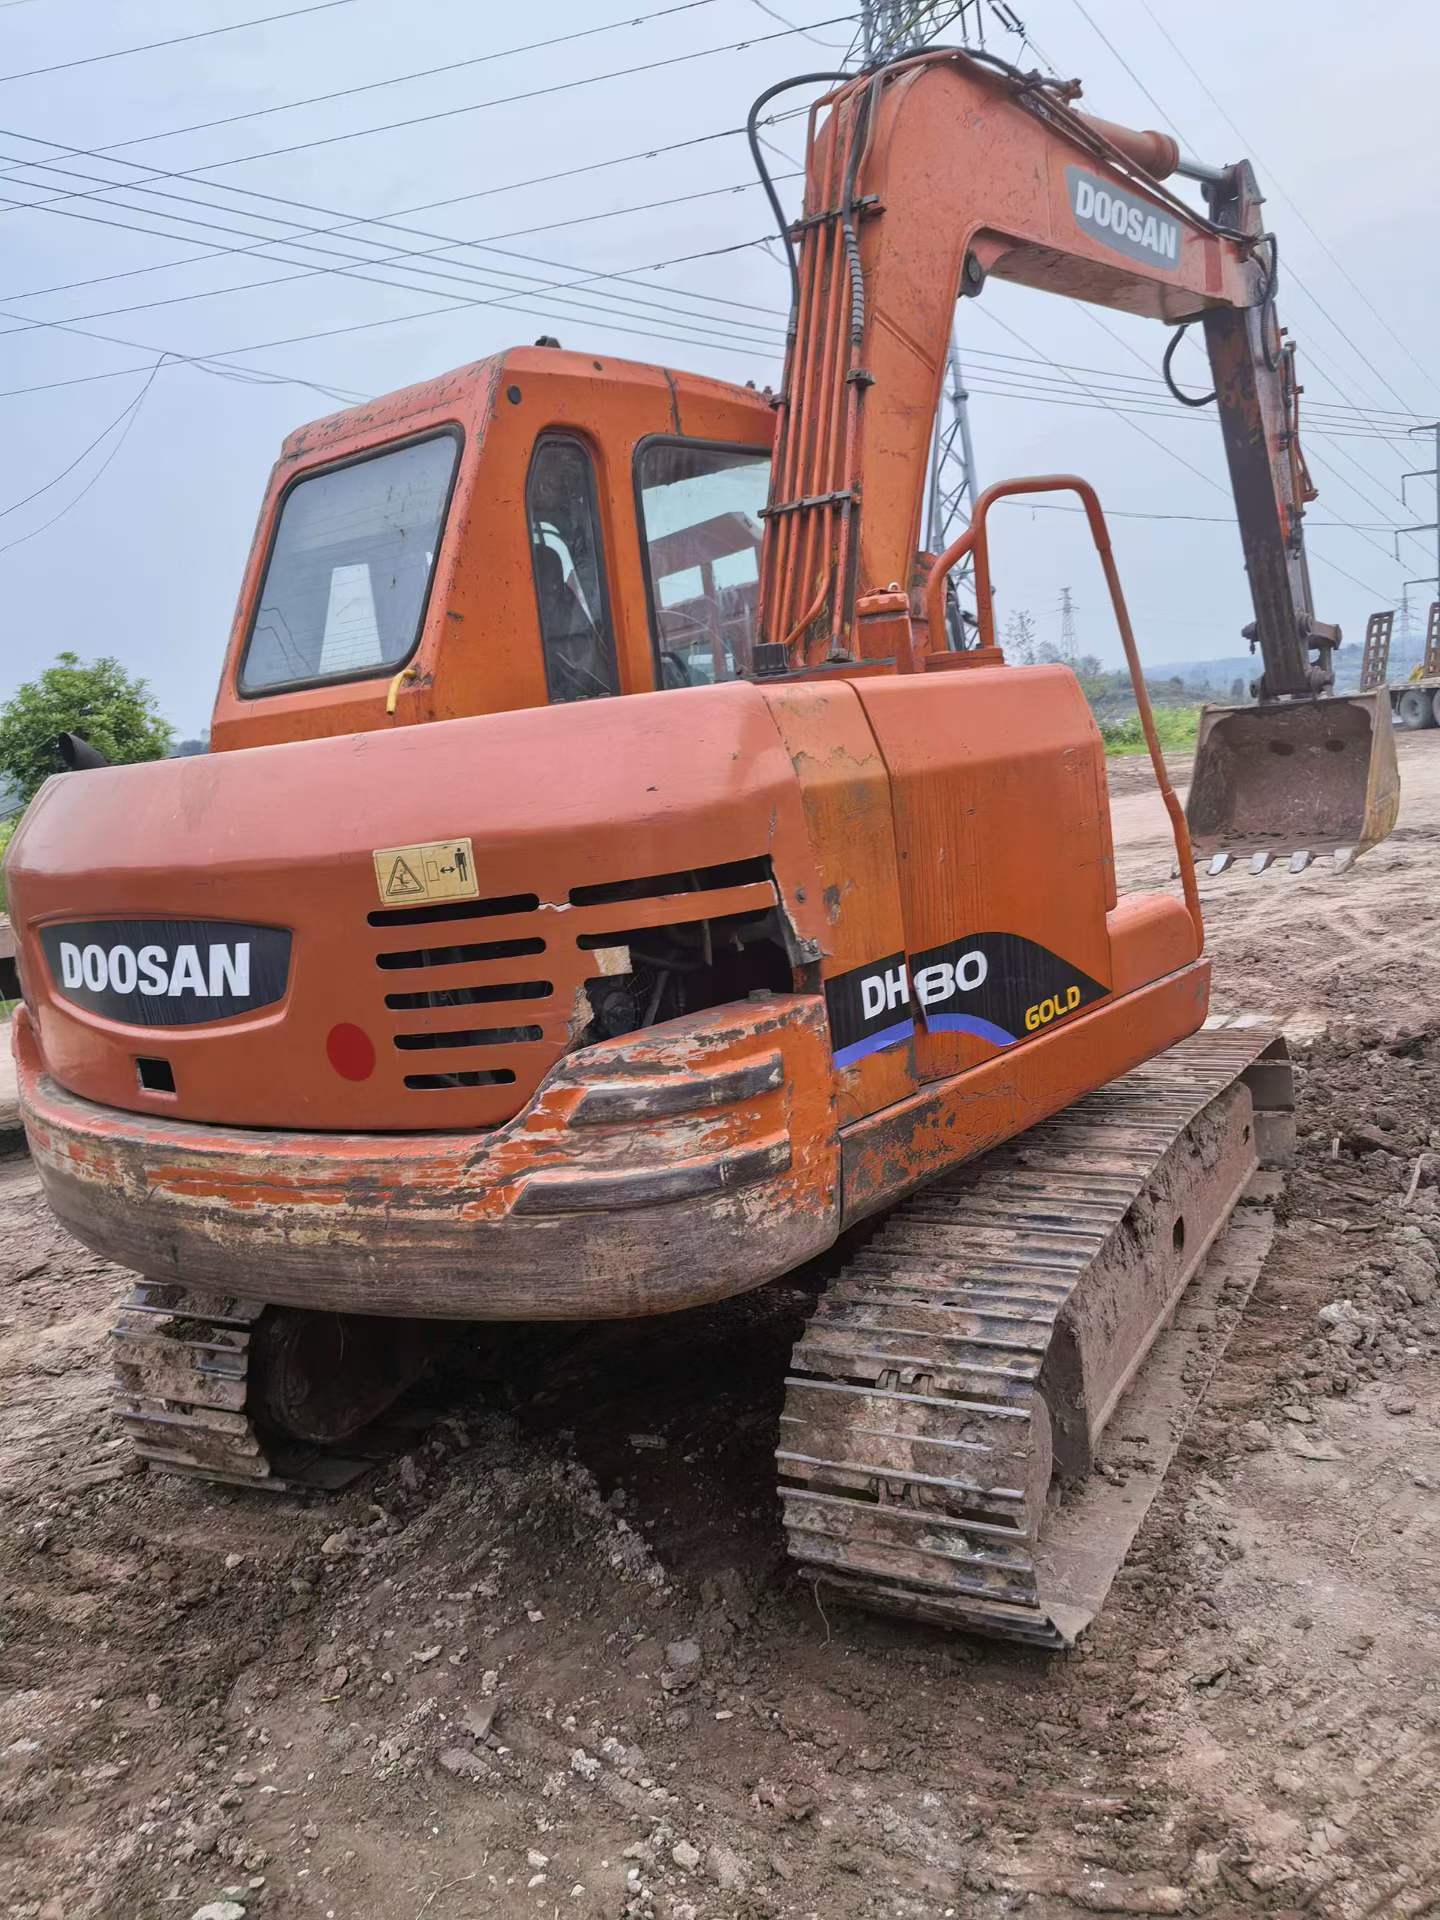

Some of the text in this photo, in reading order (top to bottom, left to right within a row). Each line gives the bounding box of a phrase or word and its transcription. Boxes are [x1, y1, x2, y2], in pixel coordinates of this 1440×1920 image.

[1075, 180, 1177, 260] DOOSAN
[60, 942, 250, 997] DOOSAN
[1025, 986, 1081, 1031] GOLD
